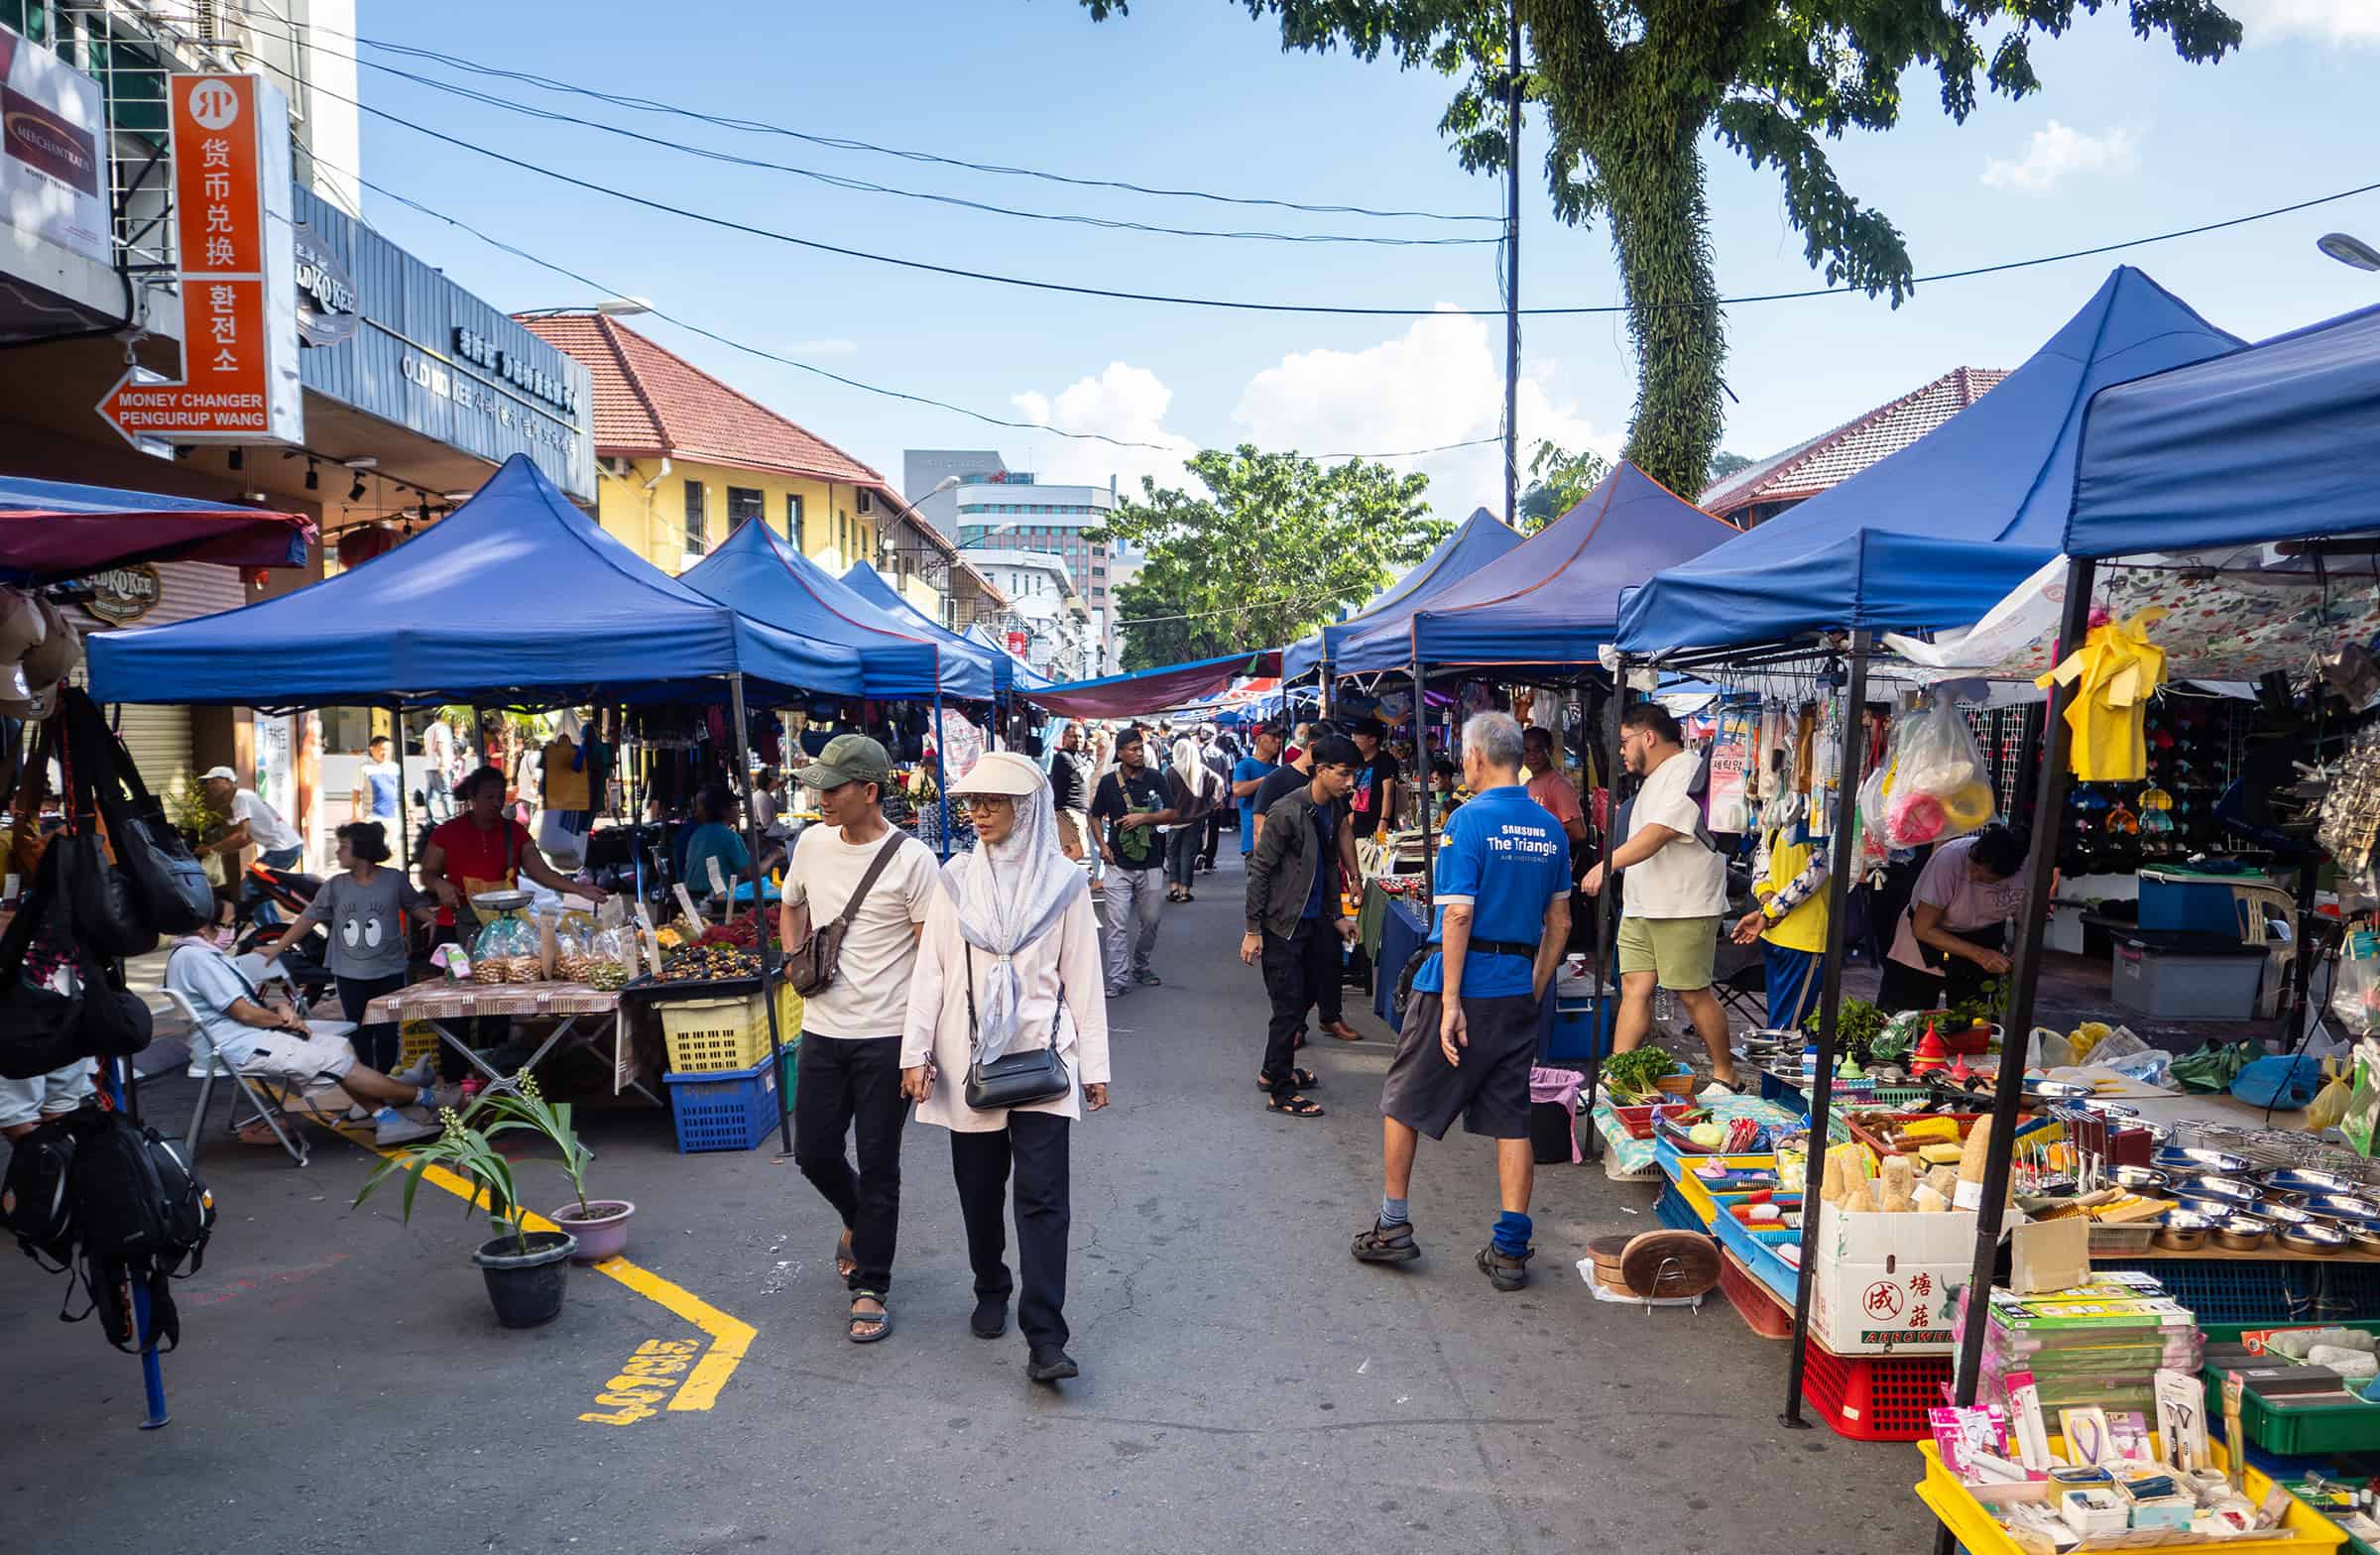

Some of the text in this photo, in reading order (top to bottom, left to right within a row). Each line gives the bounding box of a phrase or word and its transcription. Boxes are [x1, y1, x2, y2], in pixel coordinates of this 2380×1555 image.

[201, 138, 236, 266] 货币兑换
[209, 285, 239, 372] 환전소
[403, 355, 473, 410] OLD KO KEE
[119, 393, 263, 409] MONEY CHANGER
[120, 412, 265, 426] PENGURUP WANG
[1501, 824, 1546, 837] SAMSUNG
[1487, 837, 1558, 856] The Triangle
